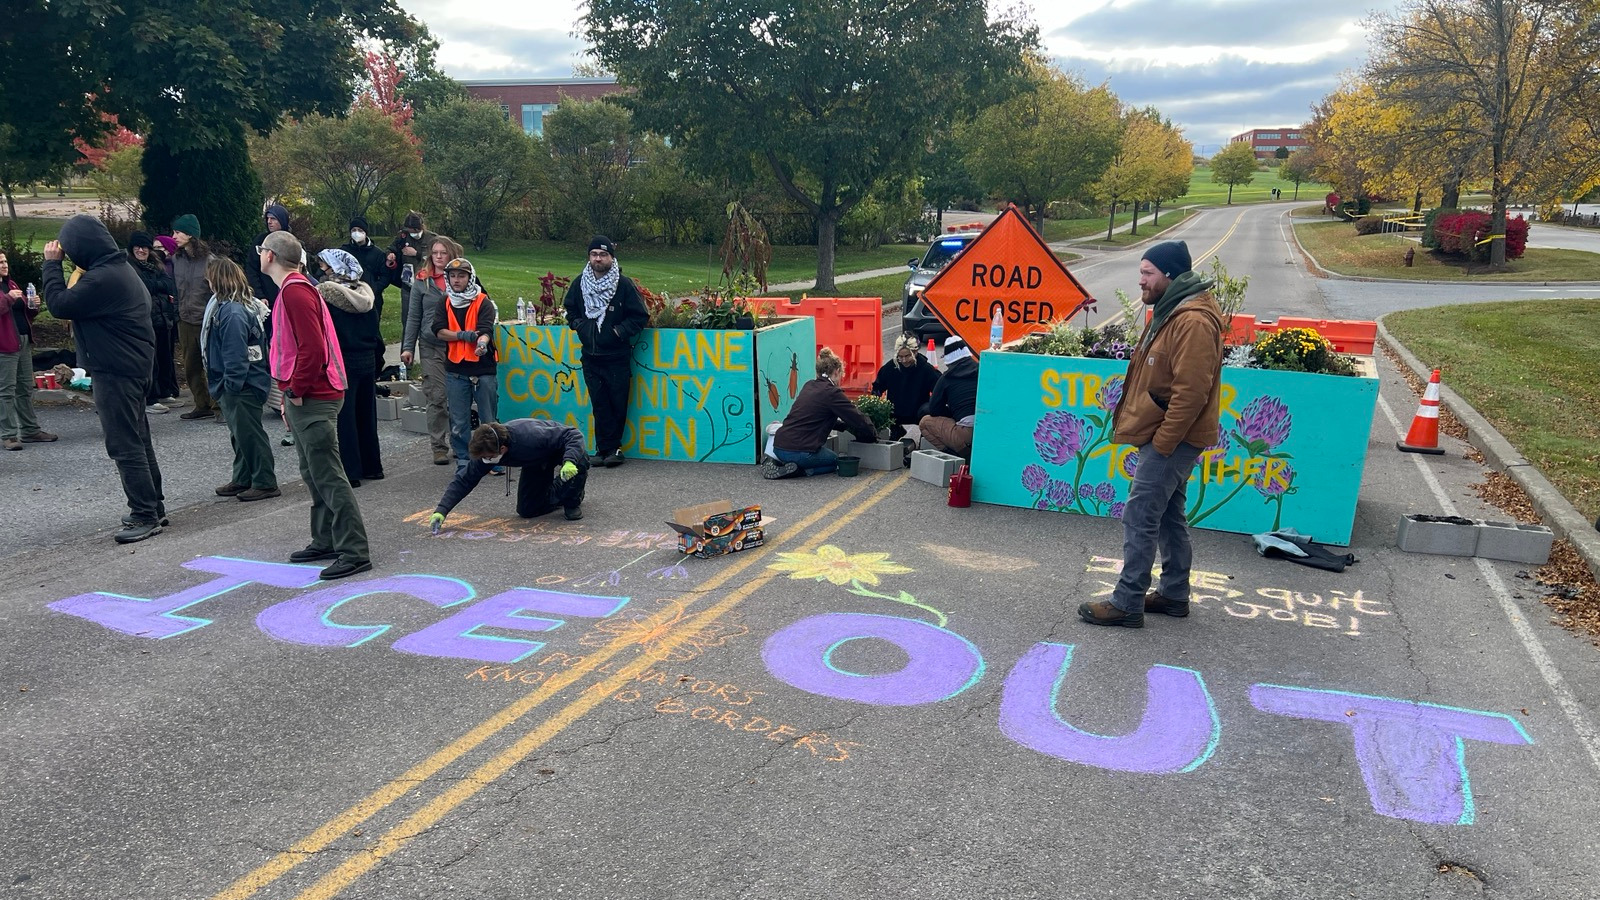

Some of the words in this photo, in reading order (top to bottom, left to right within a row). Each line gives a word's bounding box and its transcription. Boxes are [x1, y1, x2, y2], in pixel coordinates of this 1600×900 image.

[972, 264, 1042, 289] ROAD
[955, 298, 1054, 324] CLOSED
[494, 325, 583, 364] ARVE
[653, 331, 747, 371] LANE
[506, 367, 714, 411] COMNITY
[1089, 444, 1290, 491] TOTHER
[1223, 601, 1361, 636] JOB!
[1256, 587, 1391, 616] quit
[47, 556, 630, 663] ICE
[762, 613, 1534, 826] OUT
